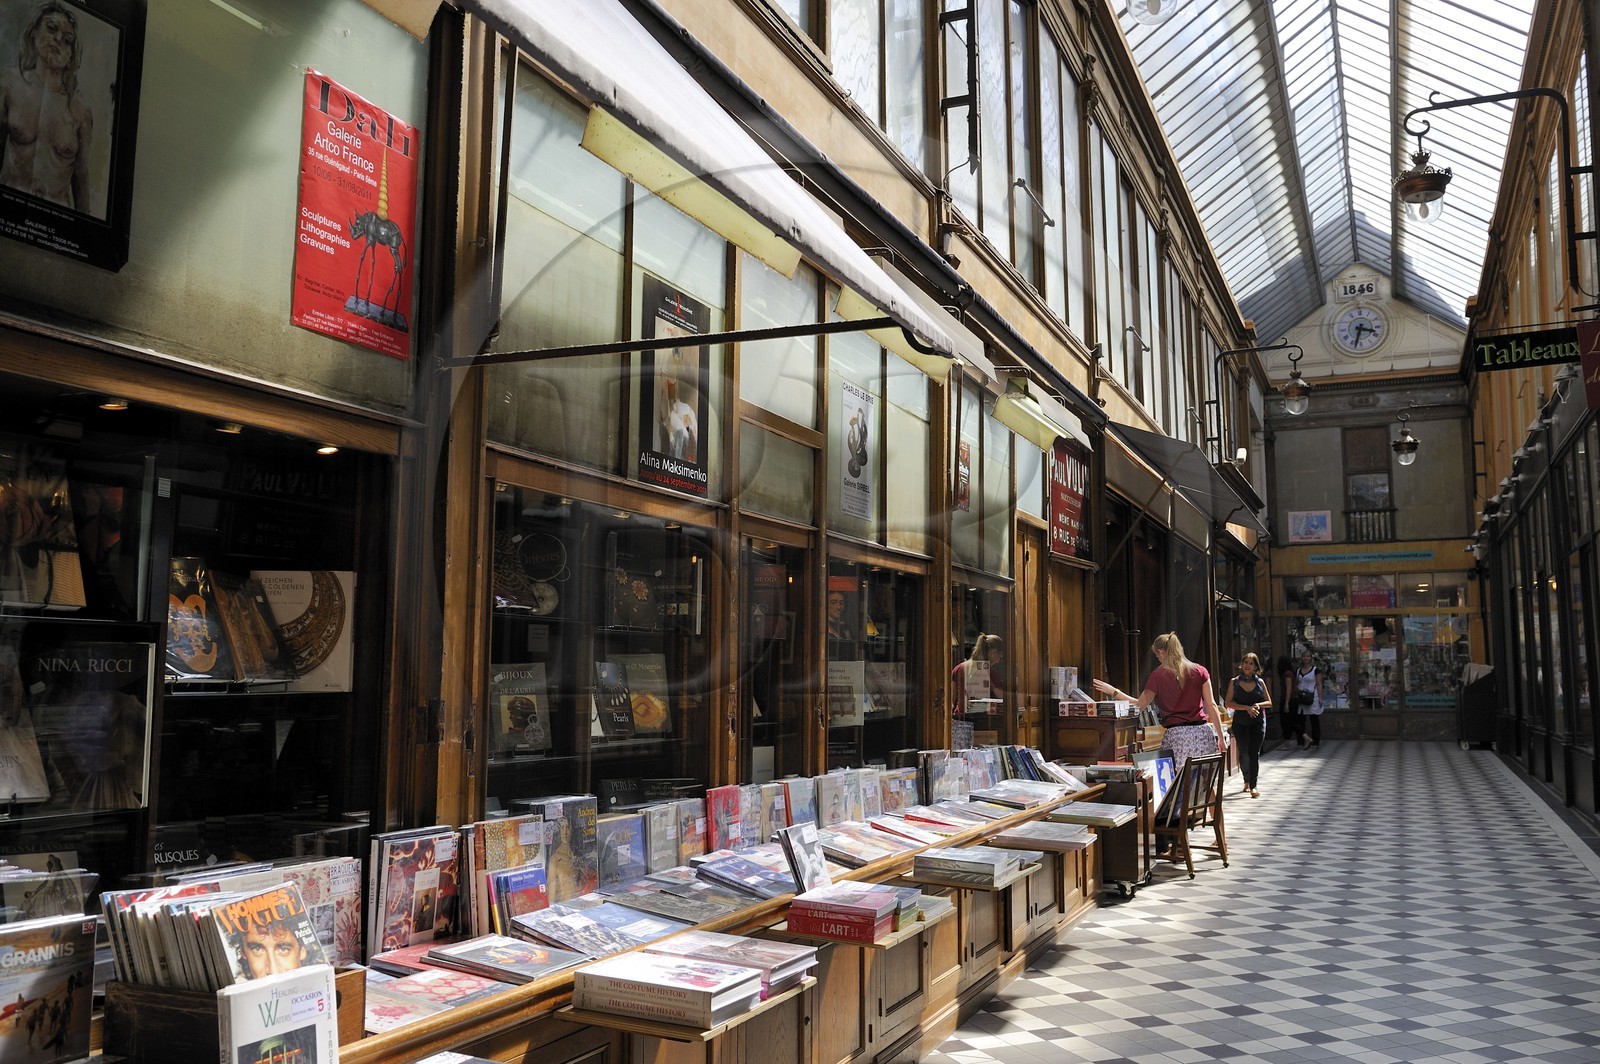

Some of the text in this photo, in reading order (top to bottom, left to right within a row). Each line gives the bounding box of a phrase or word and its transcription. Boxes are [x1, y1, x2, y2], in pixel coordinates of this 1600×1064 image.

[327, 120, 362, 149] Galerie
[314, 131, 375, 173] Artco France
[353, 168, 365, 181] Paris
[25, 219, 48, 232] GALERIE
[301, 207, 342, 231] Sculptures
[300, 220, 350, 248] Lithographies
[299, 233, 335, 255] Gravures
[1343, 283, 1374, 295] 1846
[1476, 337, 1581, 366] Tableaux
[639, 451, 707, 483] Alina Maksimenko
[1050, 445, 1067, 487] PAUL
[1053, 526, 1058, 540] 8
[1059, 527, 1070, 545] RUE
[38, 658, 134, 673] NINA RICCI
[500, 670, 533, 682] BIJOUX
[611, 780, 638, 791] PERLES
[578, 807, 595, 818] Andrea
[153, 849, 200, 864] RUSQUES
[225, 888, 290, 921] HOMMES
[808, 909, 828, 918] L'ART
[821, 922, 850, 936] L'ART
[1, 942, 75, 968] GRANNIS
[271, 986, 298, 999] HEALING
[291, 990, 323, 1004] OCCASION
[609, 980, 688, 999] THE COSTUME HISTORY
[317, 998, 325, 1012] 5
[608, 999, 687, 1018] THE COSTUME HISTORY
